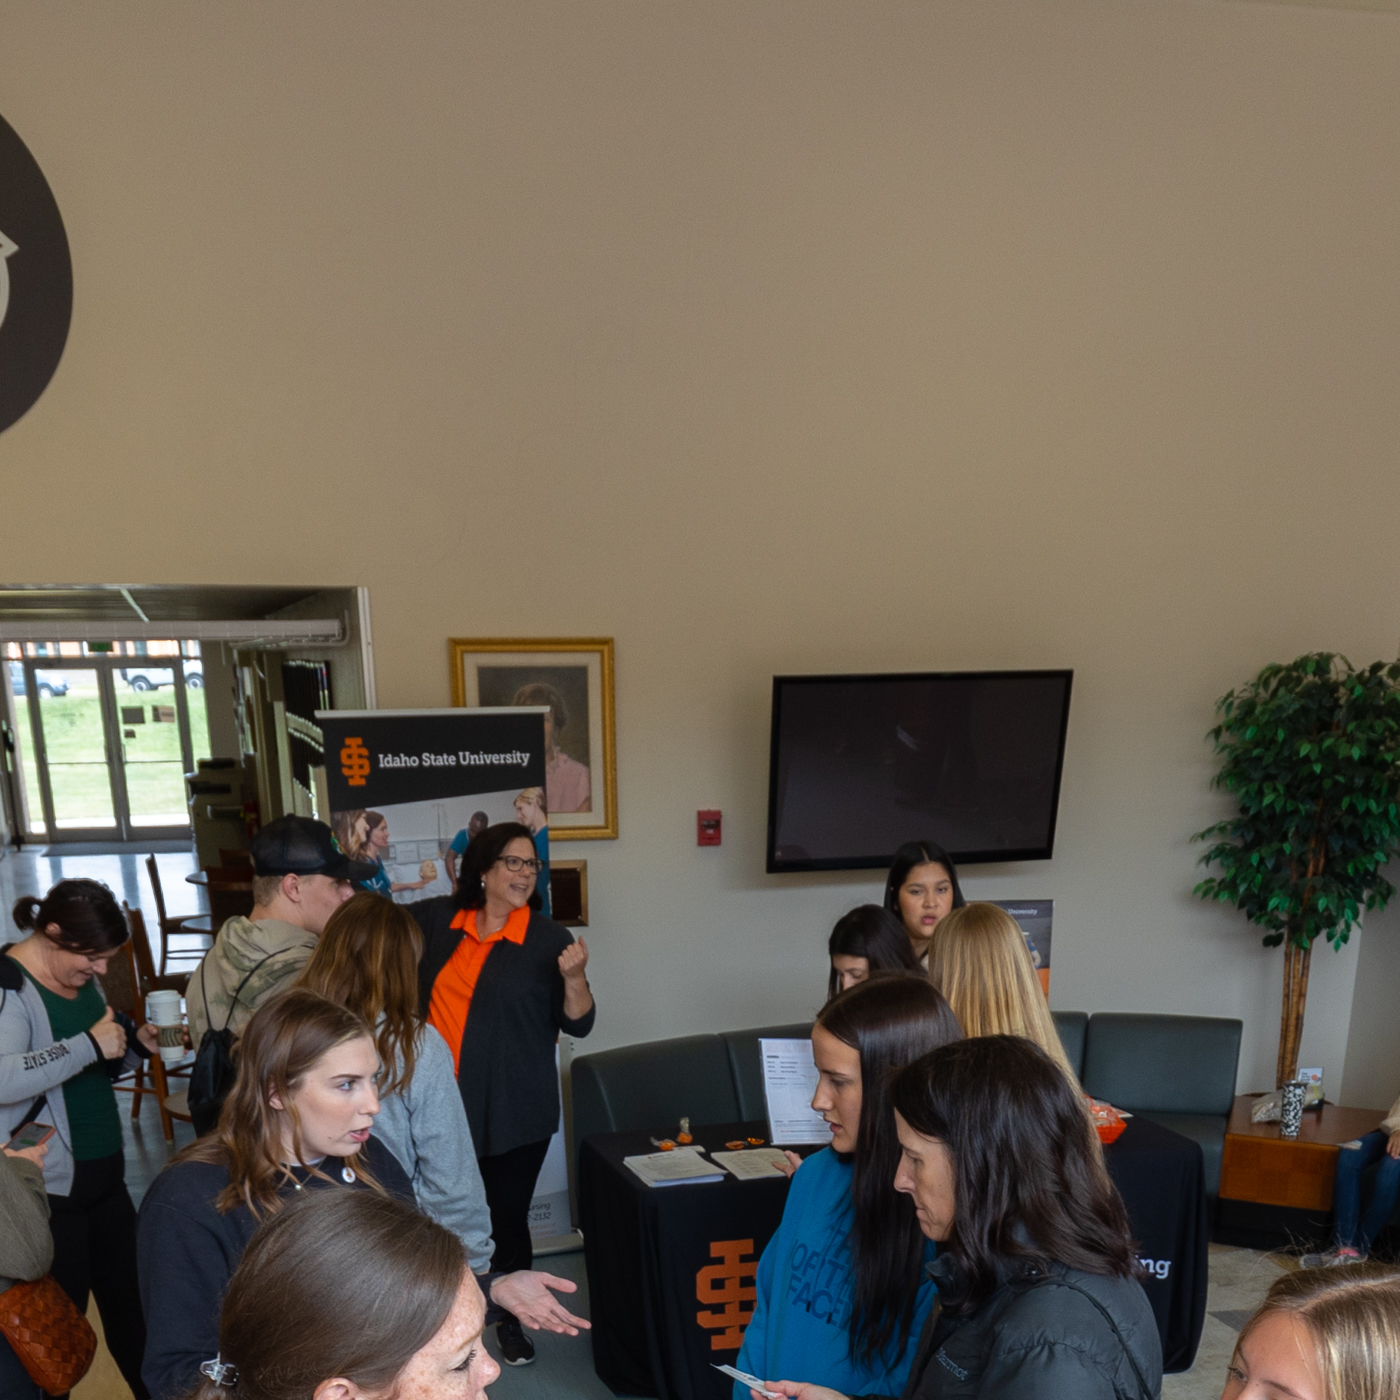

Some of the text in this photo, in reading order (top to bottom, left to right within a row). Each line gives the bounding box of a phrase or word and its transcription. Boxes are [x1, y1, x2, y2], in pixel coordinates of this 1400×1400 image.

[378, 751, 530, 767] Idaho State University
[22, 1052, 48, 1070] STATE
[529, 1203, 551, 1211] ursing
